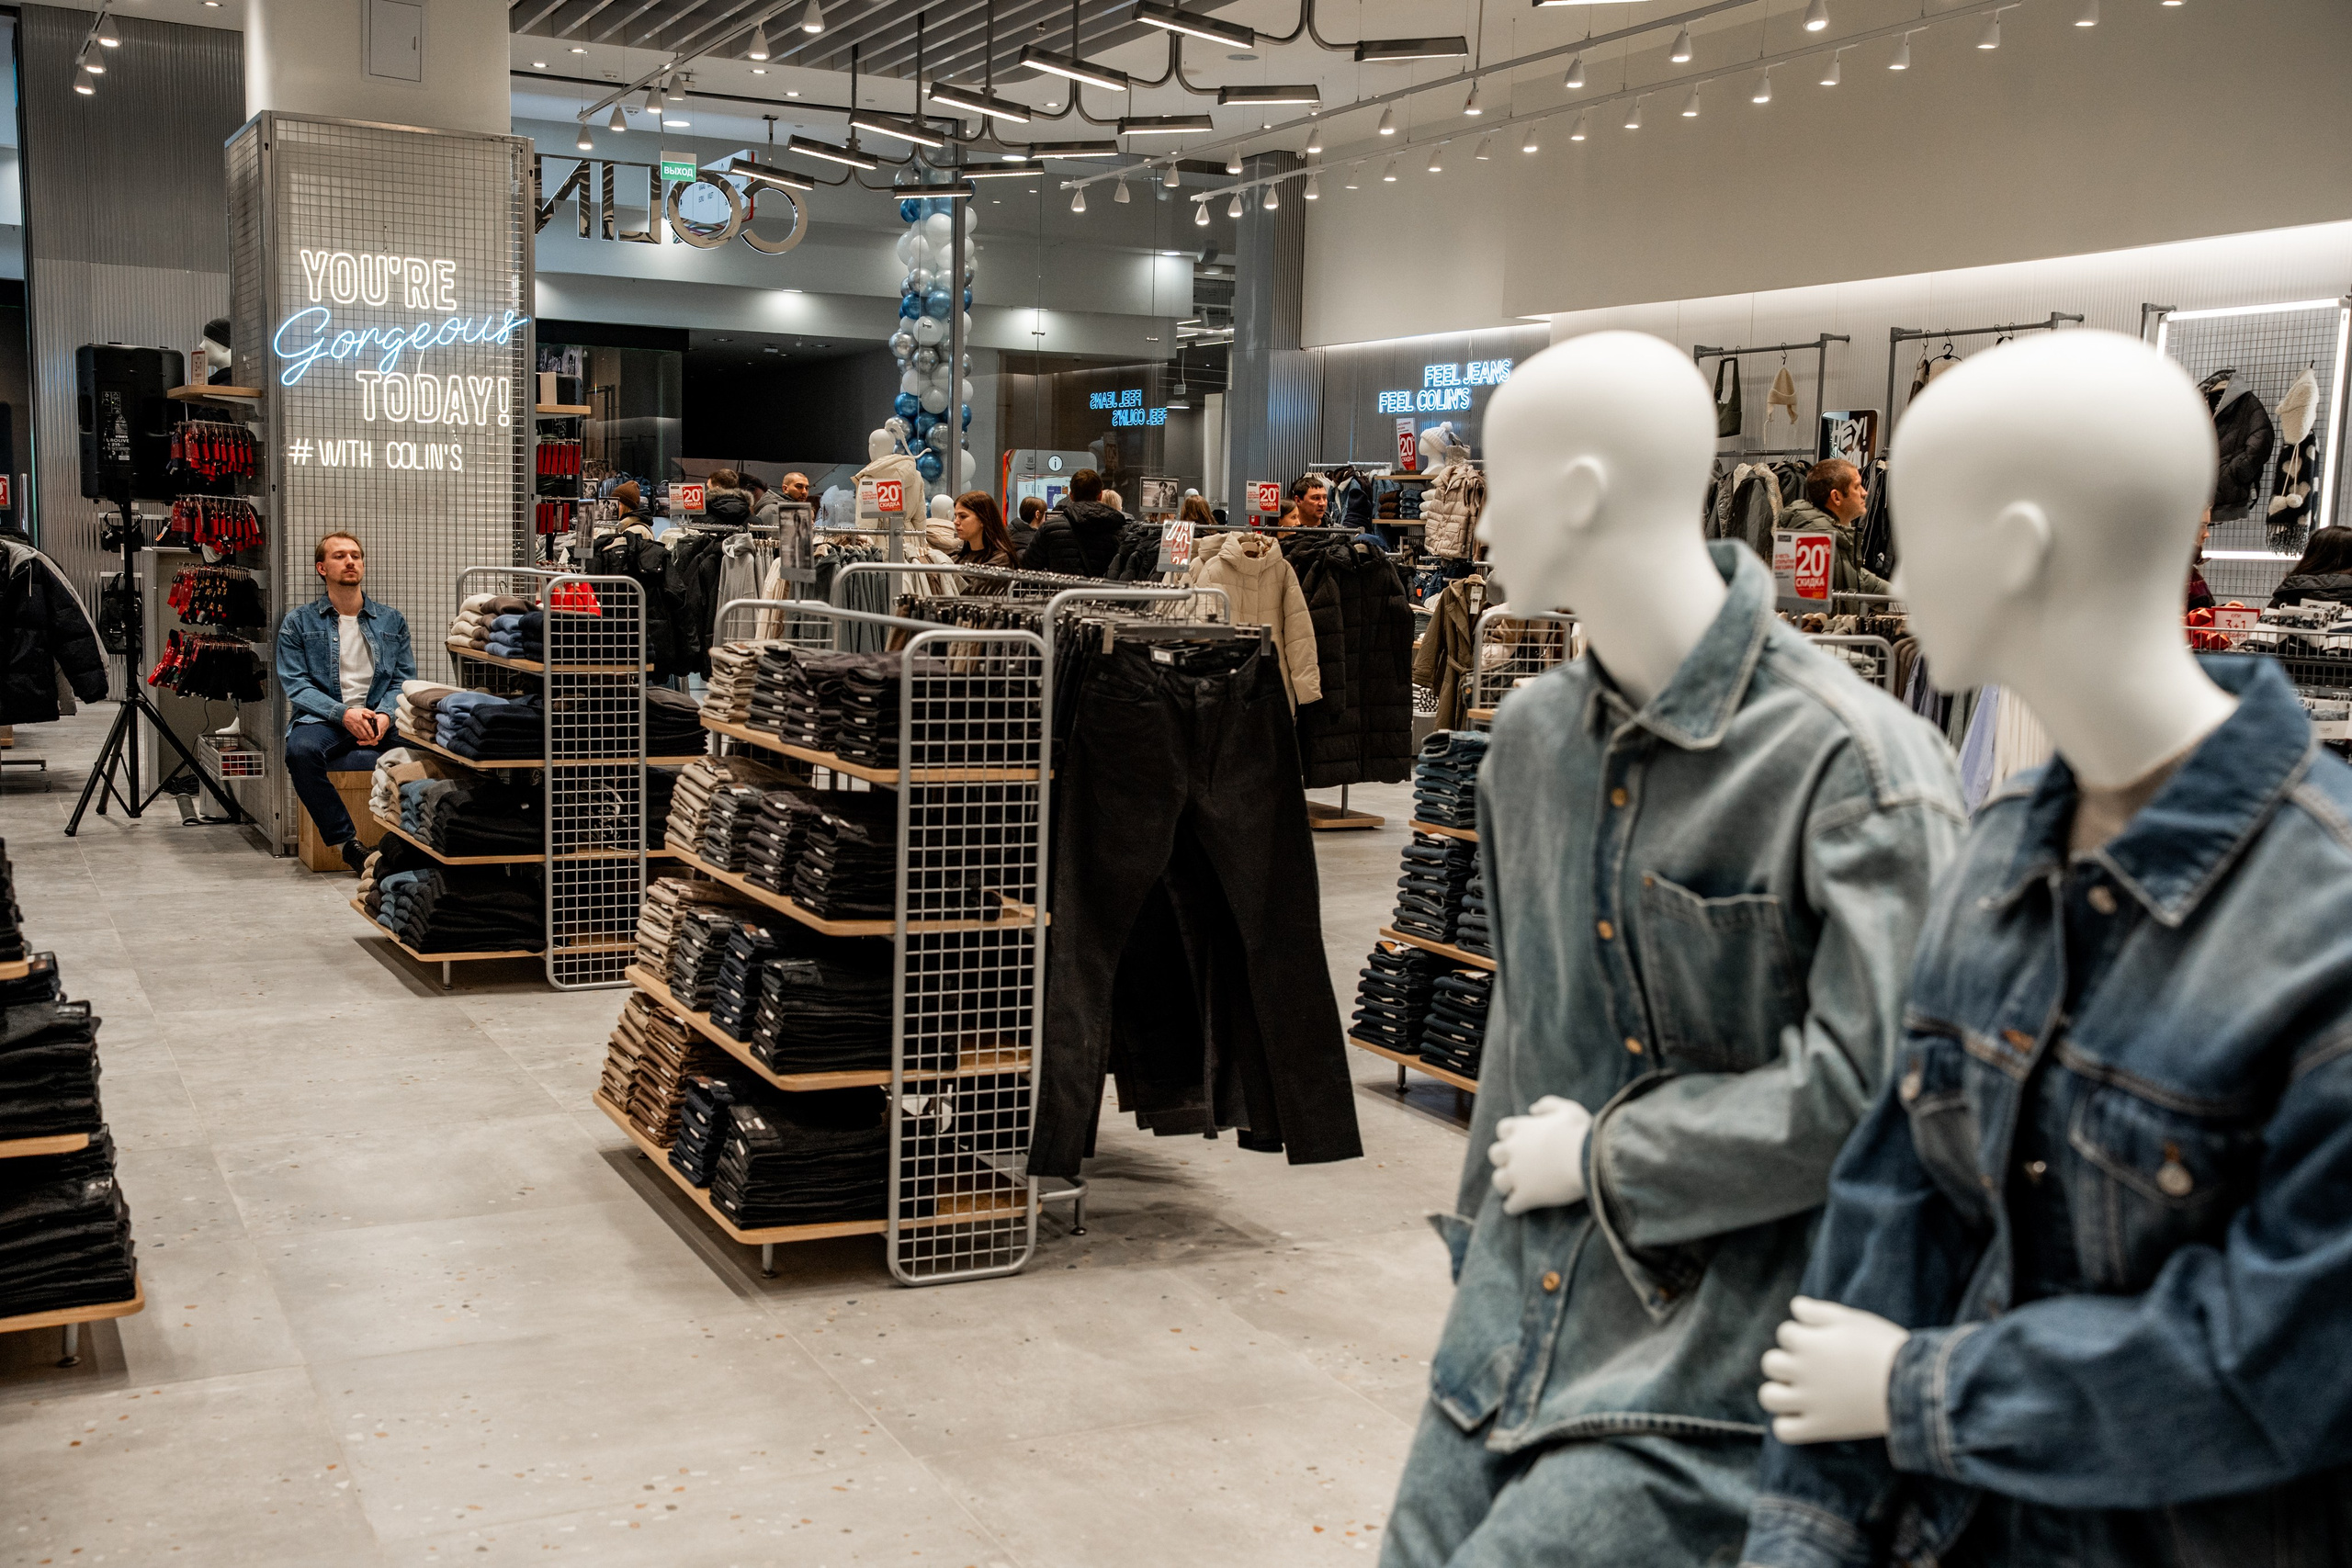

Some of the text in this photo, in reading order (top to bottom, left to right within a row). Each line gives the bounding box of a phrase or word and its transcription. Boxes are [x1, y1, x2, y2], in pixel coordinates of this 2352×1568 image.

[663, 165, 694, 178] ВЫХОД
[300, 249, 457, 311] YOU'RE
[273, 306, 531, 387] Gorgeous
[1424, 358, 1512, 387] FEEL JEANS
[356, 370, 510, 427] TODAY!
[1378, 387, 1472, 413] FEEL COLIN'S
[1831, 416, 1868, 450] HEY!
[386, 441, 463, 471] COLIN'S
[684, 488, 703, 502] 20%
[877, 484, 901, 502] 20%
[1260, 487, 1279, 502] 20%
[1796, 544, 1830, 577] 20%
[1795, 577, 1825, 589] СКИДКА
